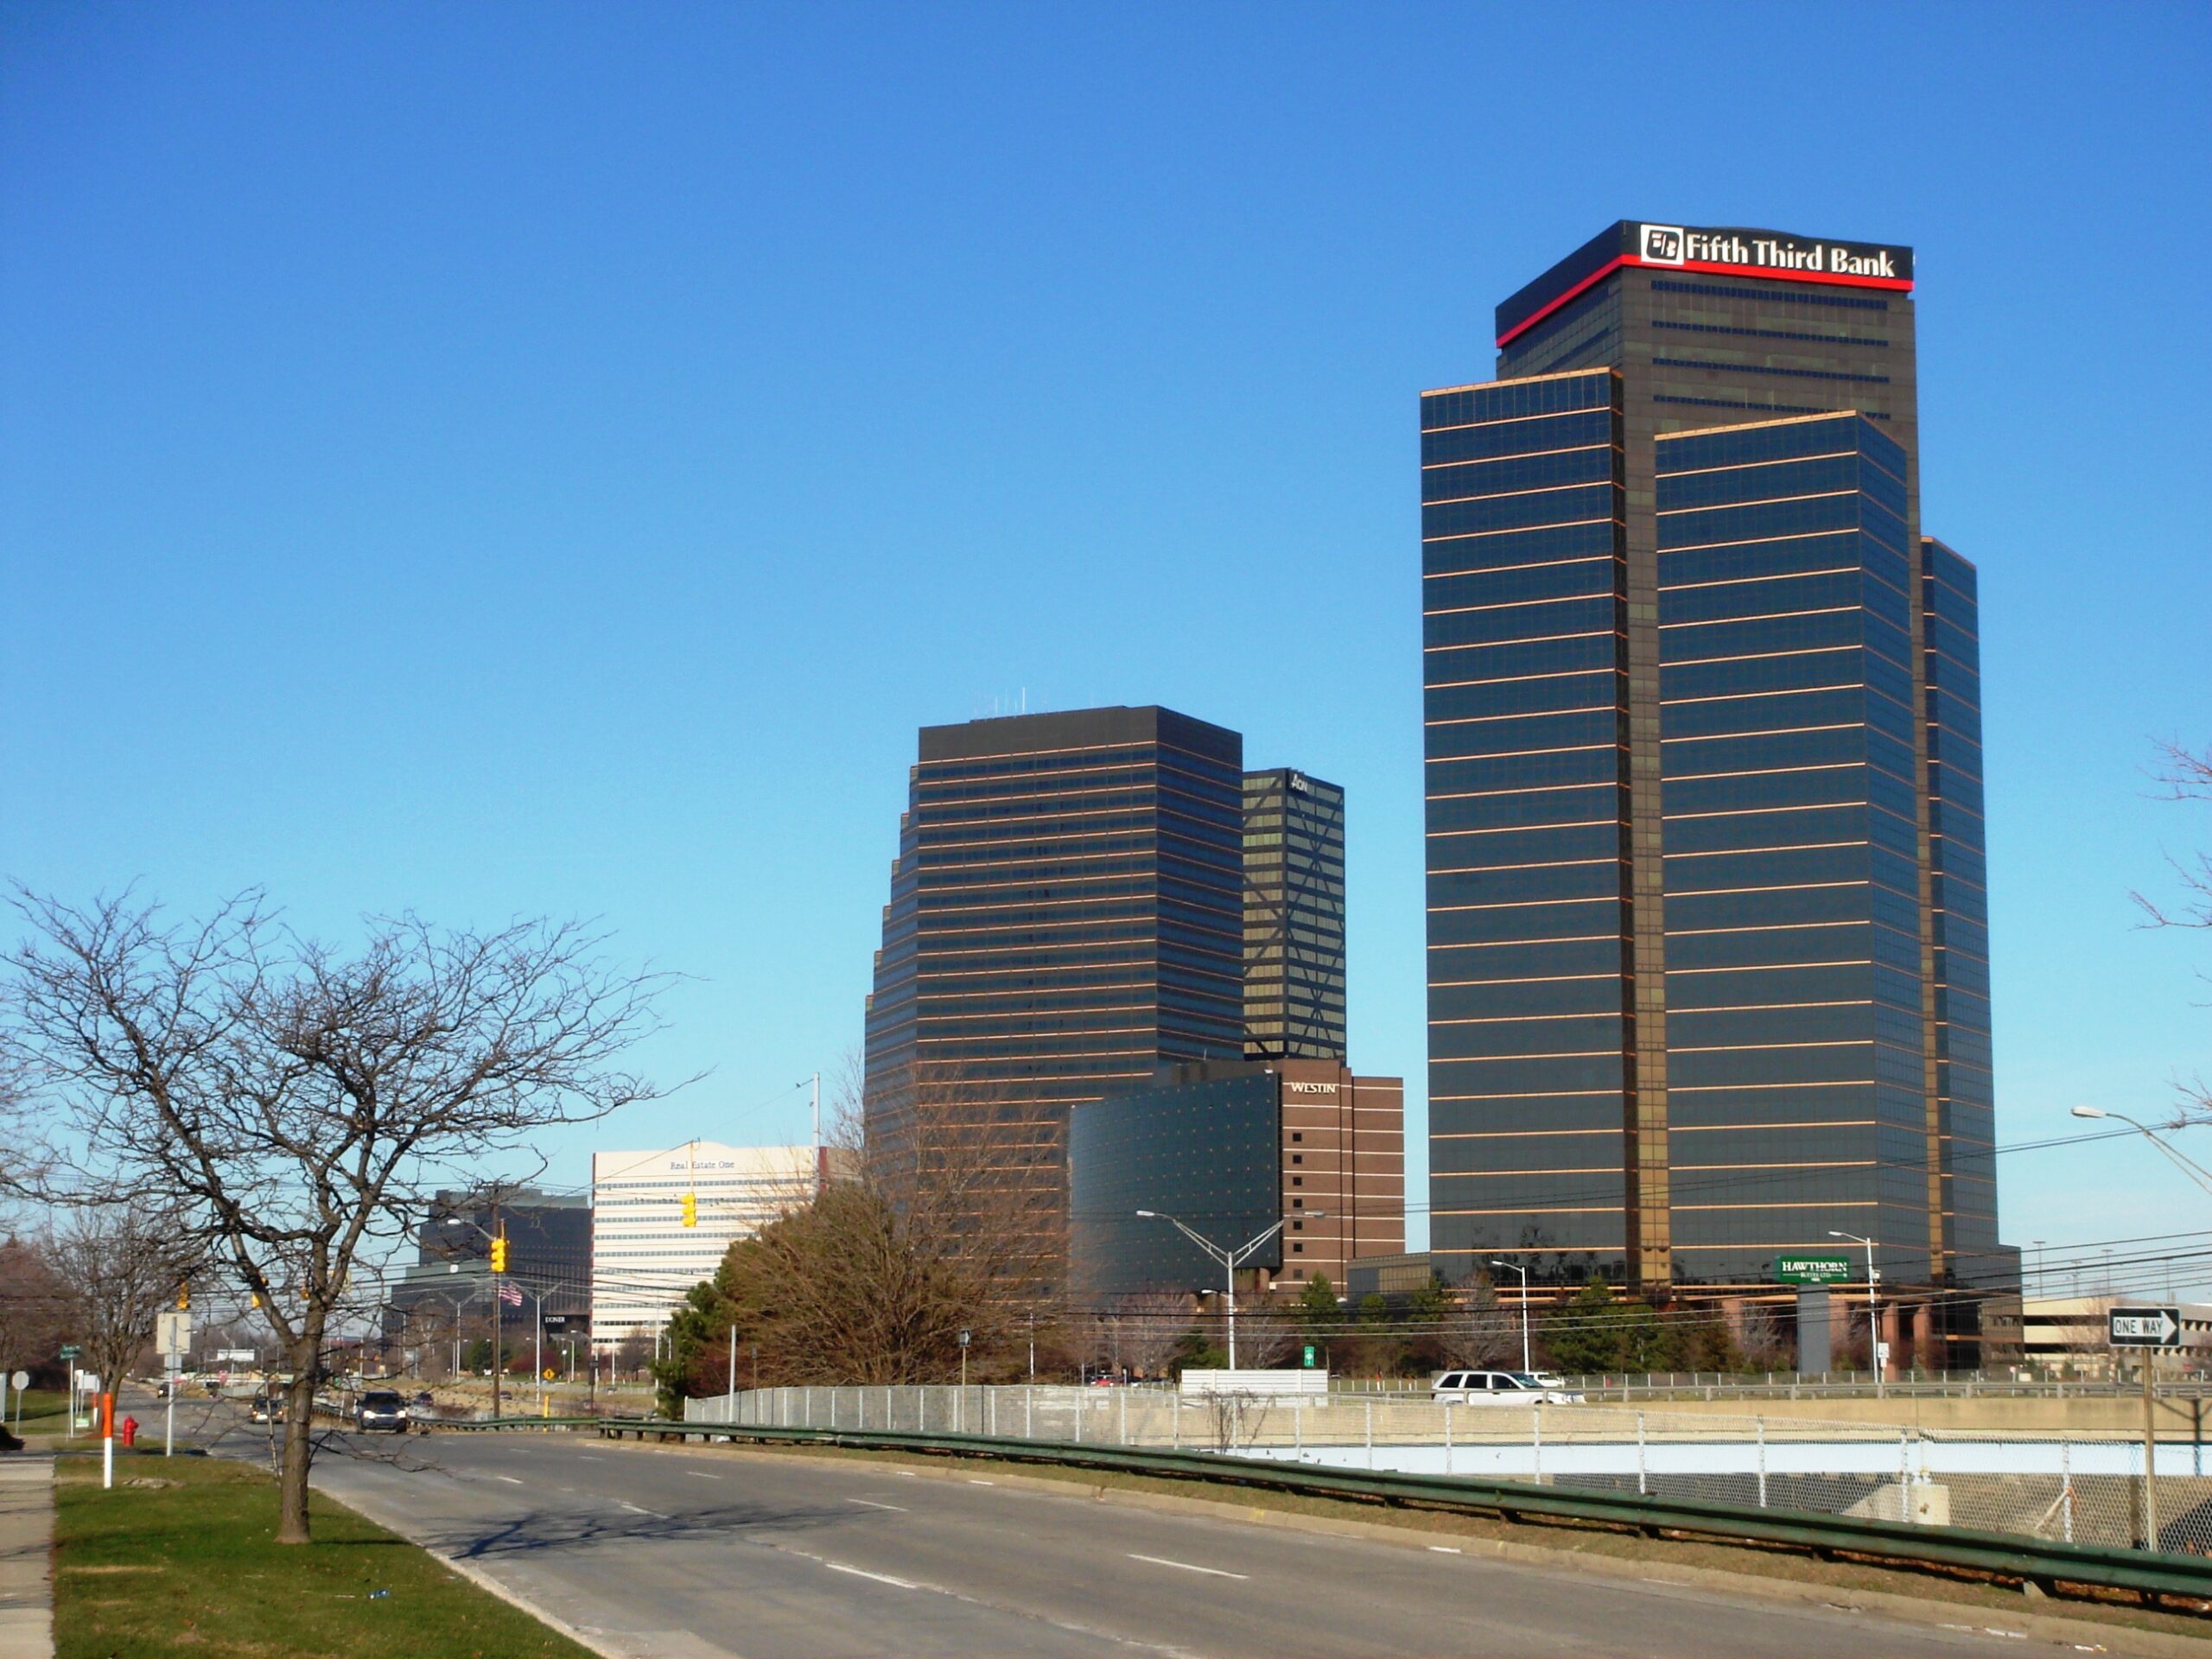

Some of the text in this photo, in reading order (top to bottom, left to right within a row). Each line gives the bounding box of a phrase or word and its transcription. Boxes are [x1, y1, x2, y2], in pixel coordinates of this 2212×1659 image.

[1687, 232, 1748, 264] Fifth
[1752, 238, 1822, 271] Third
[1831, 247, 1895, 278] Bank
[1291, 1081, 1336, 1094] WESTIN
[671, 1161, 689, 1170] Real
[719, 1160, 735, 1169] One
[1782, 1262, 1847, 1272] HAWTHORN
[2114, 1319, 2164, 1334] ONE WAY
